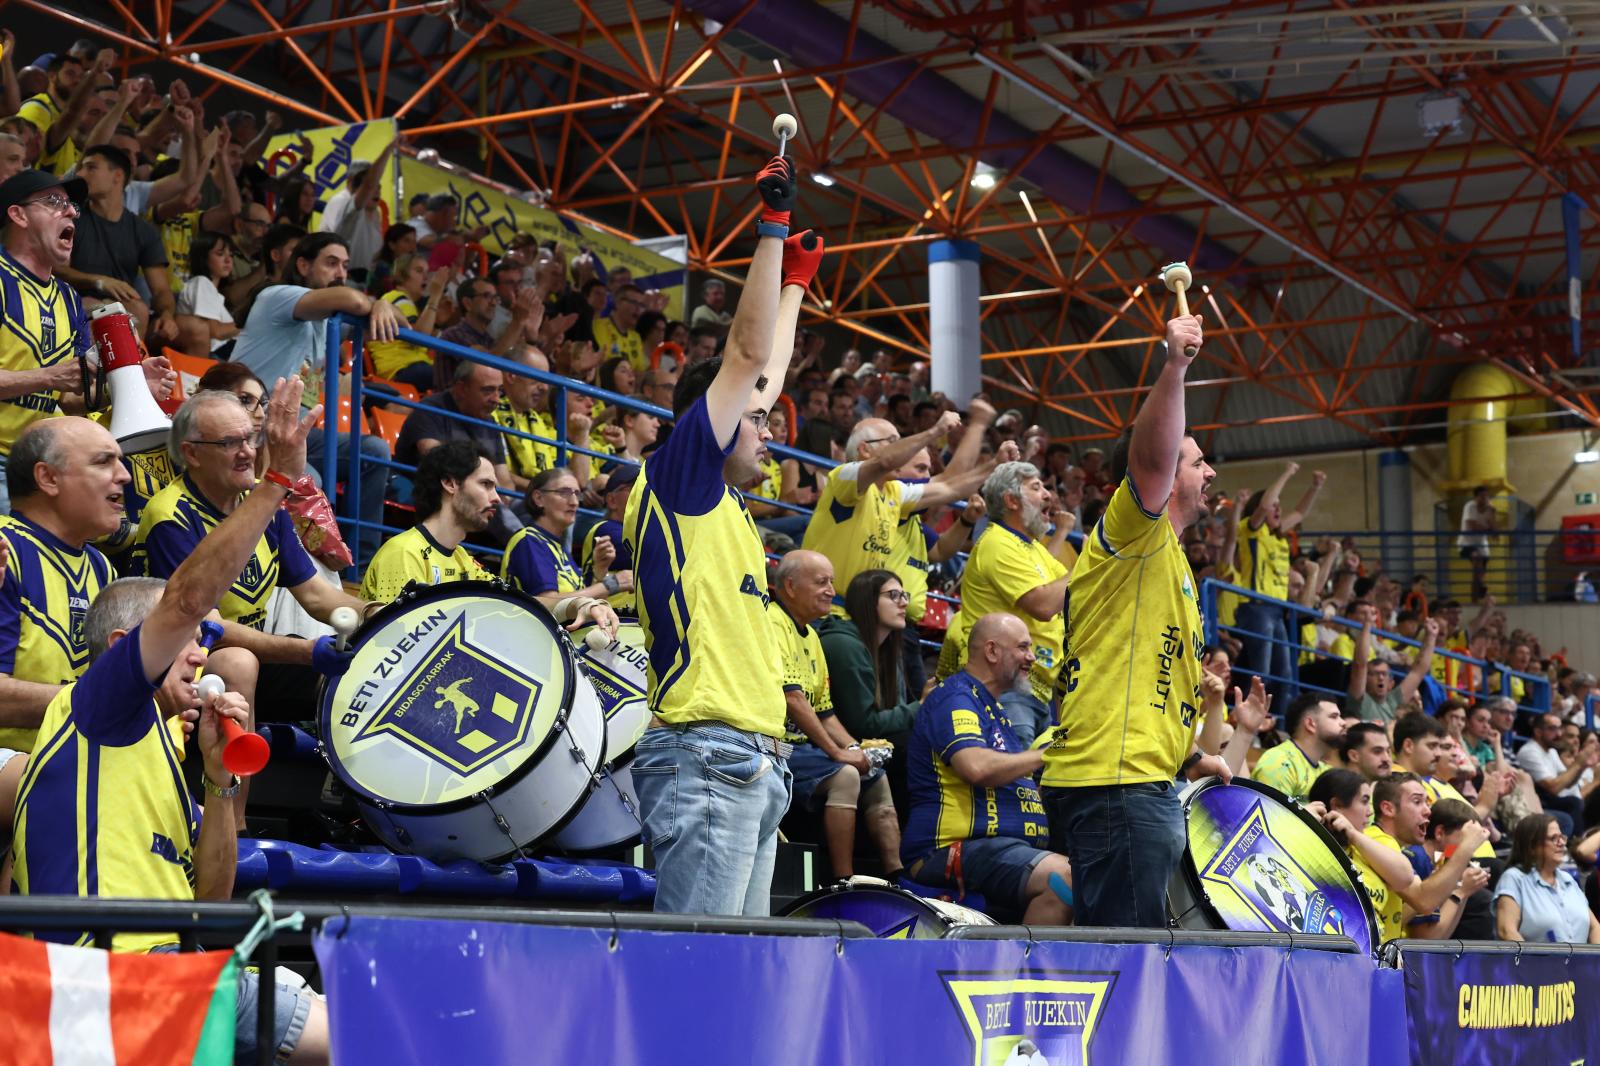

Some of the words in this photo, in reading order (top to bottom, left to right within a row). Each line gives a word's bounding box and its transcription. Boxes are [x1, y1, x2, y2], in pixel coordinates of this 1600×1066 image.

[339, 680, 379, 728] BETI
[373, 608, 448, 679] ZUEKIN
[394, 651, 455, 718] BIDASOTARRAK
[1221, 853, 1240, 876] BETI
[1238, 821, 1264, 854] ZUEKIN
[1024, 1000, 1087, 1027] ZUEKIN
[1458, 983, 1533, 1029] CAMINANDO
[1534, 980, 1577, 1027] JUNTOS
